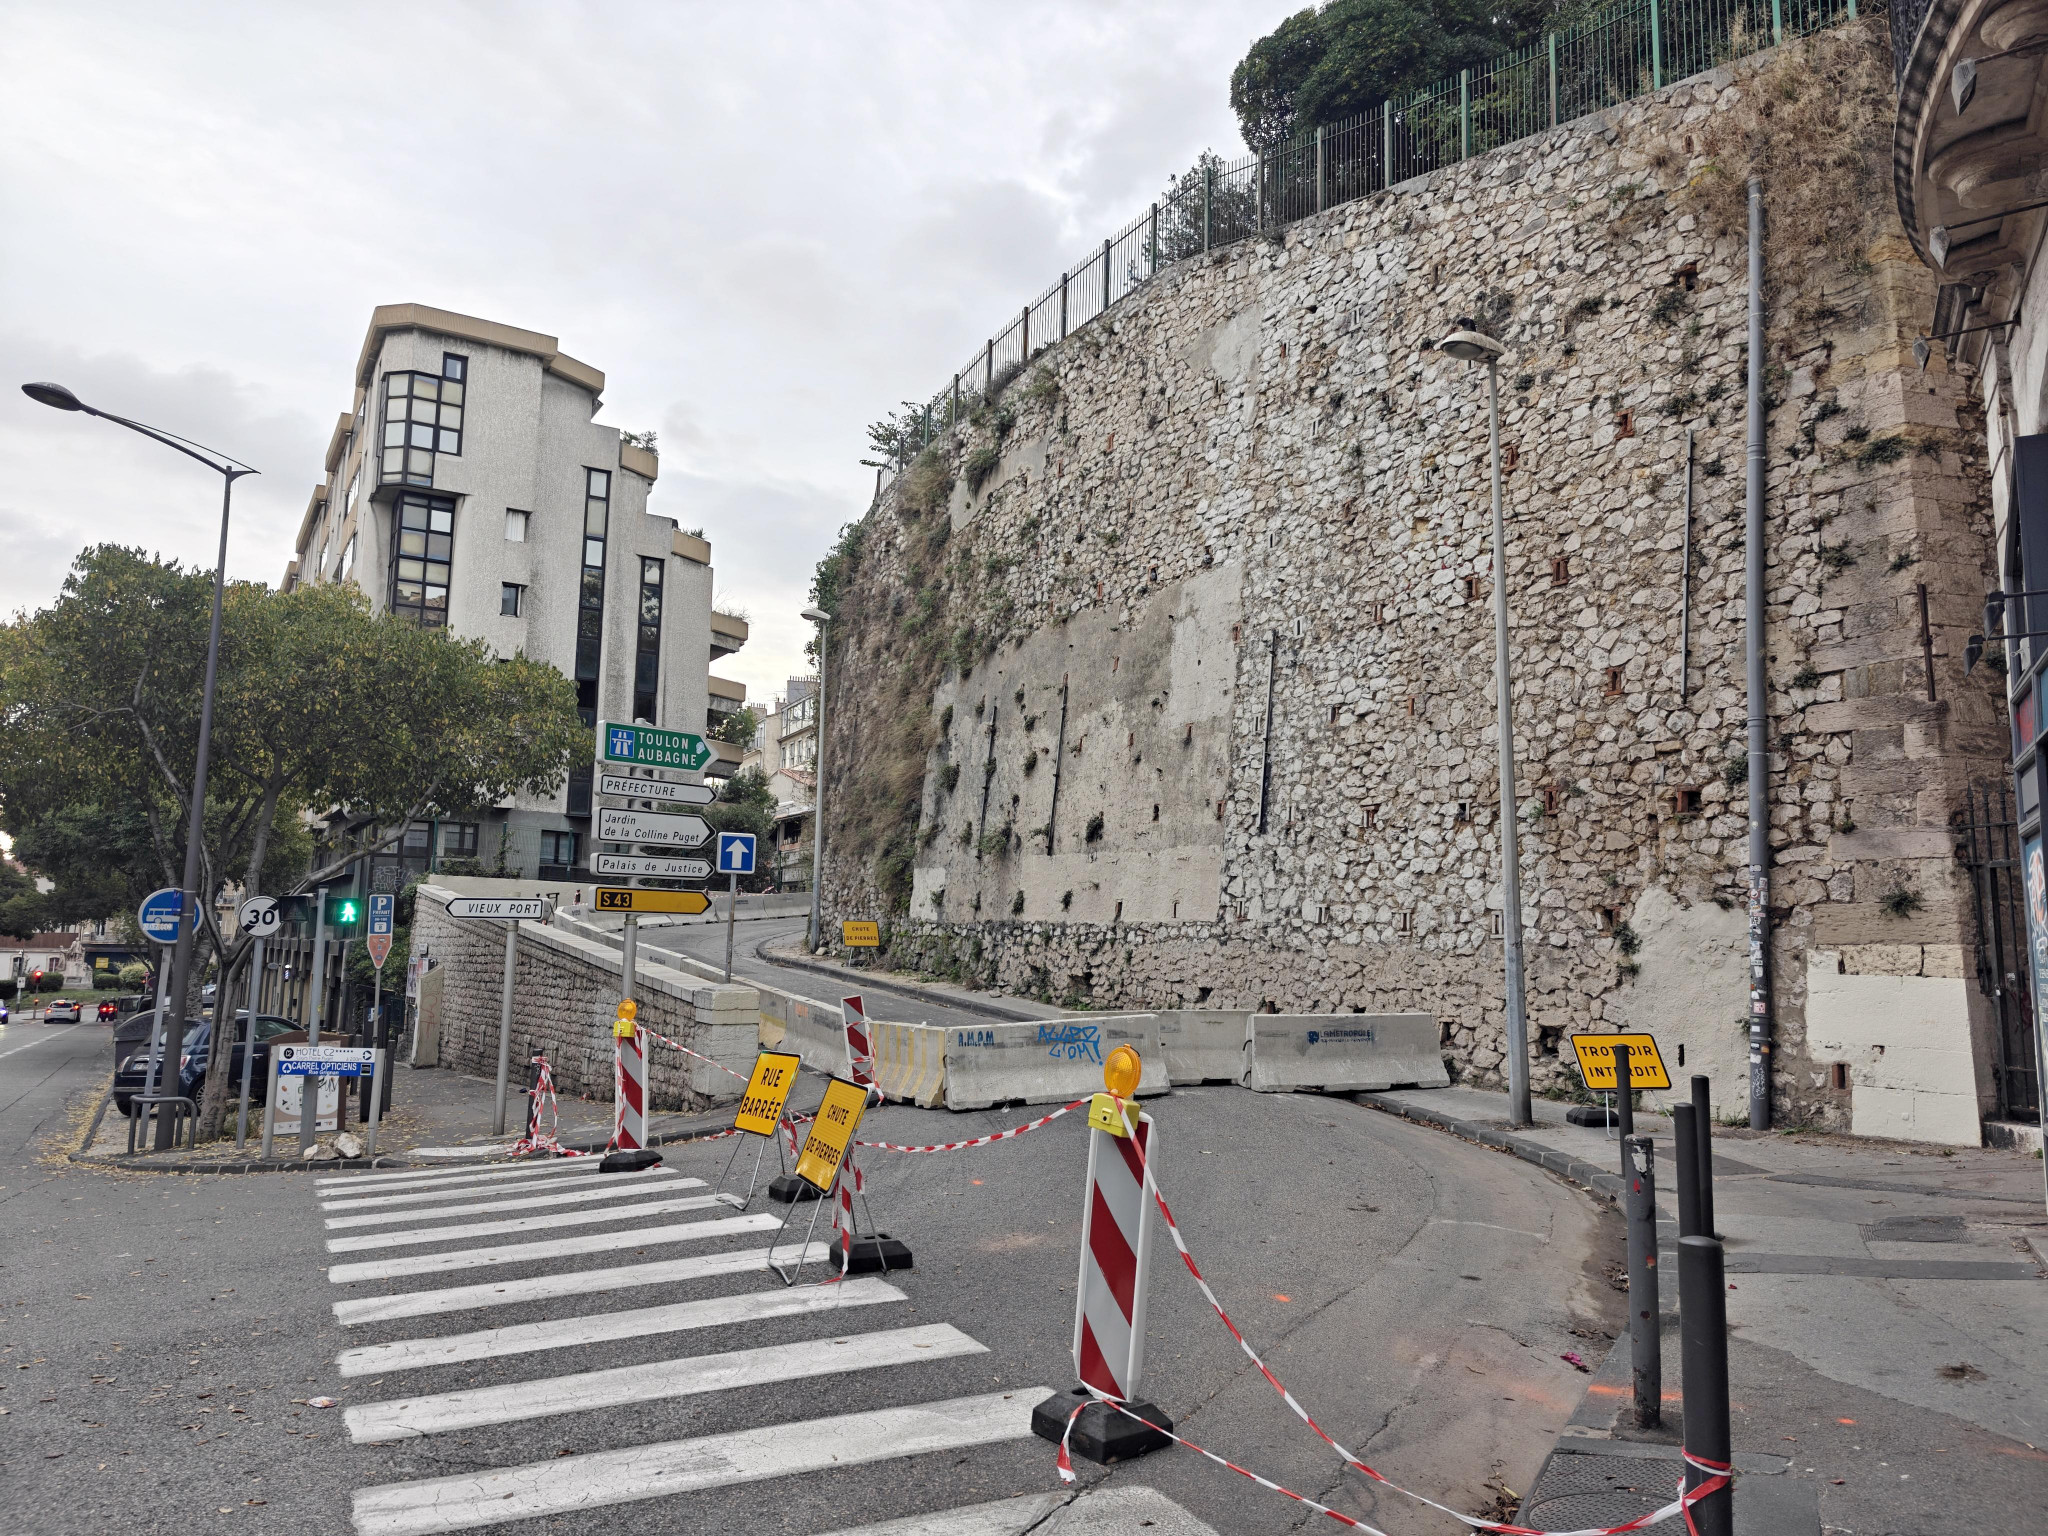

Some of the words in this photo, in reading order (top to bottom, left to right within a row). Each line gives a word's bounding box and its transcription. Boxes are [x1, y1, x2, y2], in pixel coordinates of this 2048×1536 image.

[638, 731, 689, 750] TOULON
[637, 747, 697, 766] AUBAGNE
[606, 779, 676, 797] PRÉFECTURE
[605, 813, 636, 825] Jardin
[604, 826, 616, 837] de
[620, 827, 630, 837] la
[634, 828, 668, 840] Colline
[672, 831, 700, 844] Puget
[602, 859, 637, 871] Palais
[644, 861, 657, 872] de
[664, 863, 703, 874] Justice
[377, 897, 387, 911] P
[468, 903, 502, 914] VIEUX
[508, 903, 539, 914] PORT
[602, 893, 611, 907] S
[613, 893, 631, 907] 43
[248, 909, 275, 926] 30
[295, 1047, 321, 1057] HOTEL
[323, 1048, 335, 1057] C2
[1580, 1045, 1653, 1057] TROTOIR
[291, 1061, 320, 1071] CARREL
[321, 1062, 357, 1072] OPTICIENS
[760, 1067, 784, 1088] RUE
[740, 1096, 782, 1121] BARRÉE
[826, 1103, 850, 1126] CHUTE
[805, 1136, 817, 1153] DE
[816, 1139, 842, 1167] PIERRES
